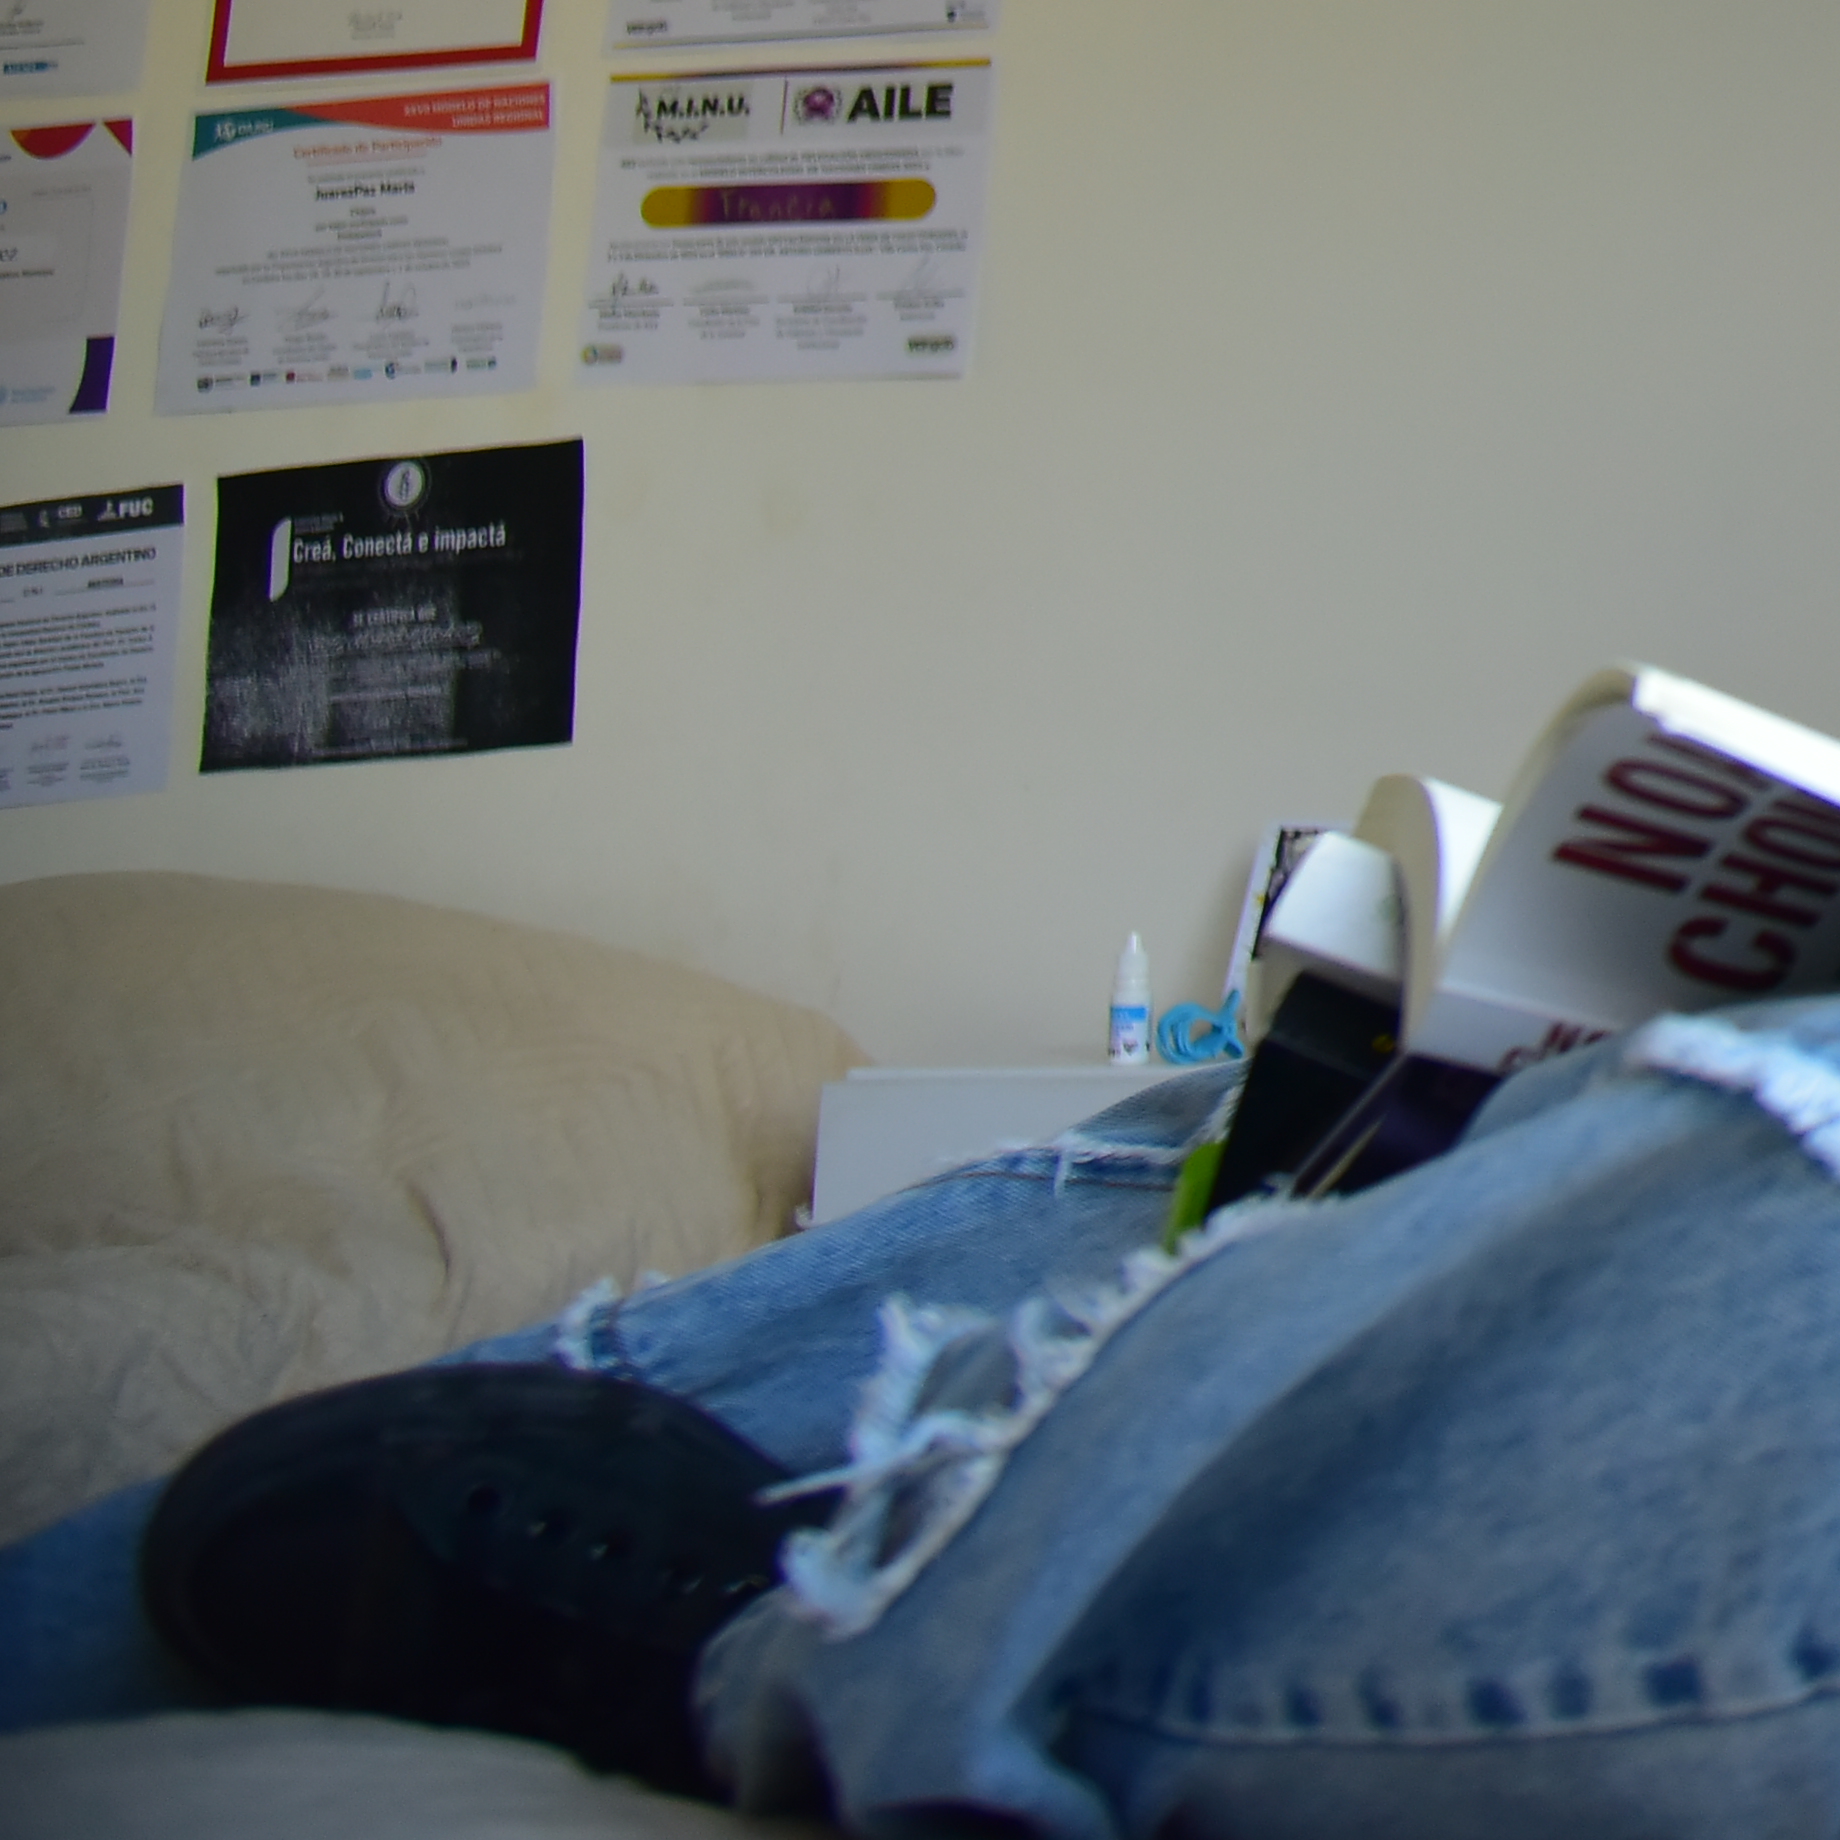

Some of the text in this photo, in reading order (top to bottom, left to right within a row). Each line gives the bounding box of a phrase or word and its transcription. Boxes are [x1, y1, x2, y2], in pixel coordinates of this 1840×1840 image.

[656, 94, 750, 122] M.I.N.U.
[848, 83, 954, 123] AILE
[119, 496, 154, 519] FUC
[342, 529, 413, 560] Conectá
[418, 535, 429, 554] e
[433, 520, 507, 555] impactá
[16, 554, 79, 576] DERECHO
[81, 546, 157, 568] ARGENTINO
